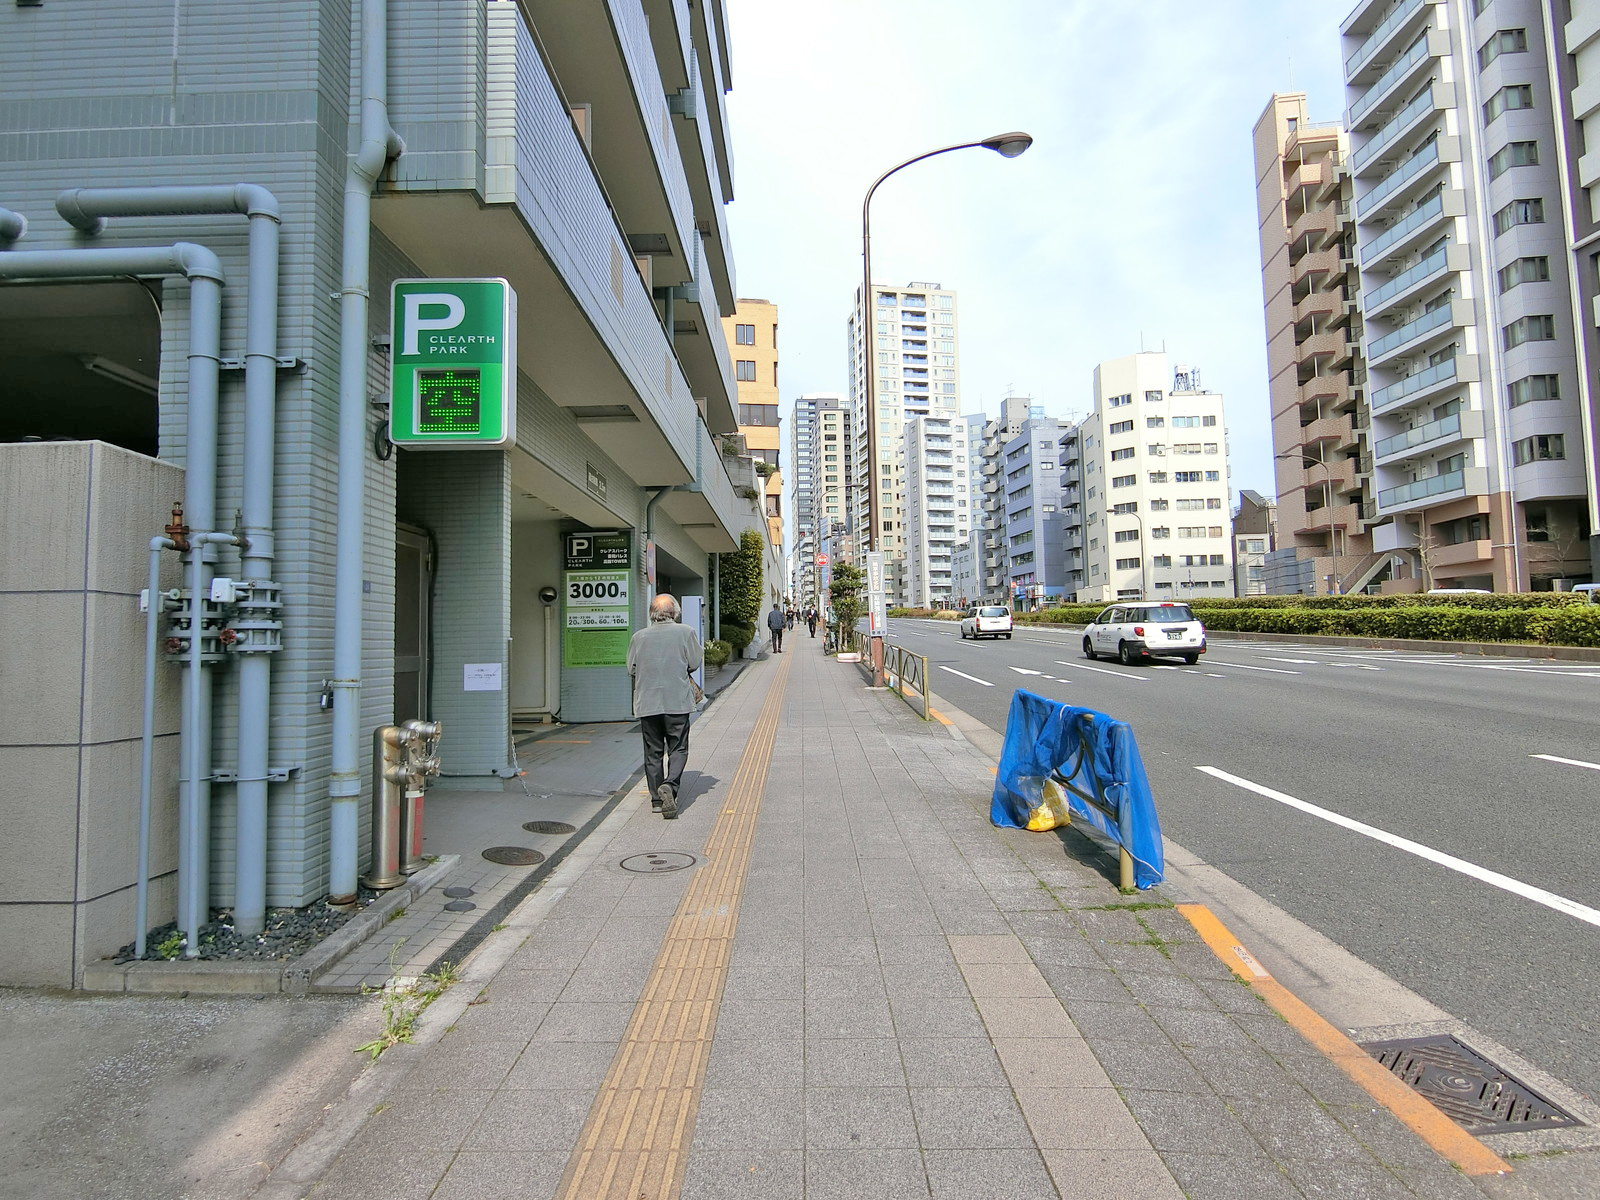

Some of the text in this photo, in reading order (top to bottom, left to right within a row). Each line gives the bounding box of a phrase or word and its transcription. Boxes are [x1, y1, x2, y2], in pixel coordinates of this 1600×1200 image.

[401, 293, 466, 356] P
[429, 335, 496, 344] CLEARTH
[429, 346, 468, 354] PARK
[419, 371, 480, 431] 空
[572, 539, 589, 556] P
